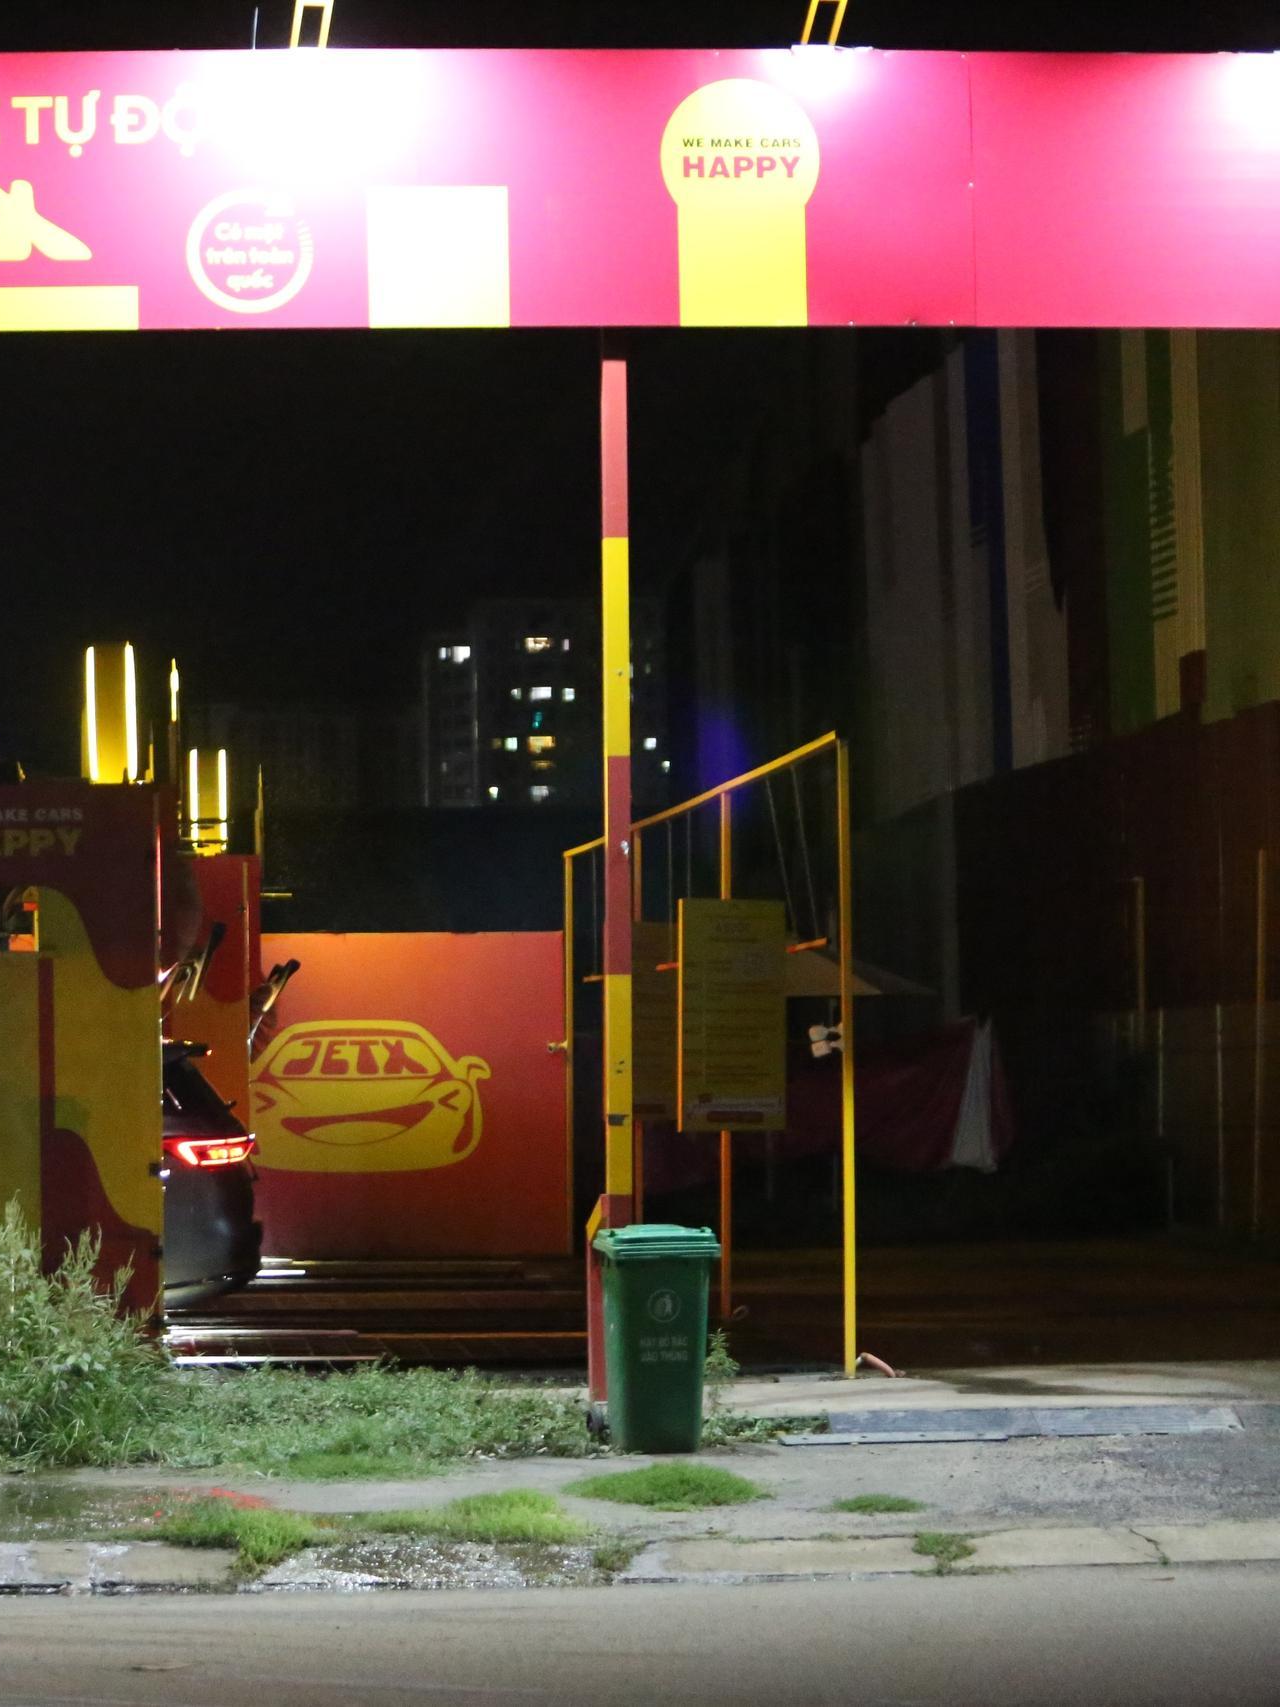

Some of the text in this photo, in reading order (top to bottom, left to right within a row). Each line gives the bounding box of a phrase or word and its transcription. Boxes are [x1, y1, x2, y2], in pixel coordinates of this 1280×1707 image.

[12, 90, 101, 158] TỰ
[682, 138, 801, 148] WE MAKE CARS
[683, 156, 800, 178] HAPPY
[33, 807, 84, 822] CARS
[282, 1039, 429, 1076] JETX
